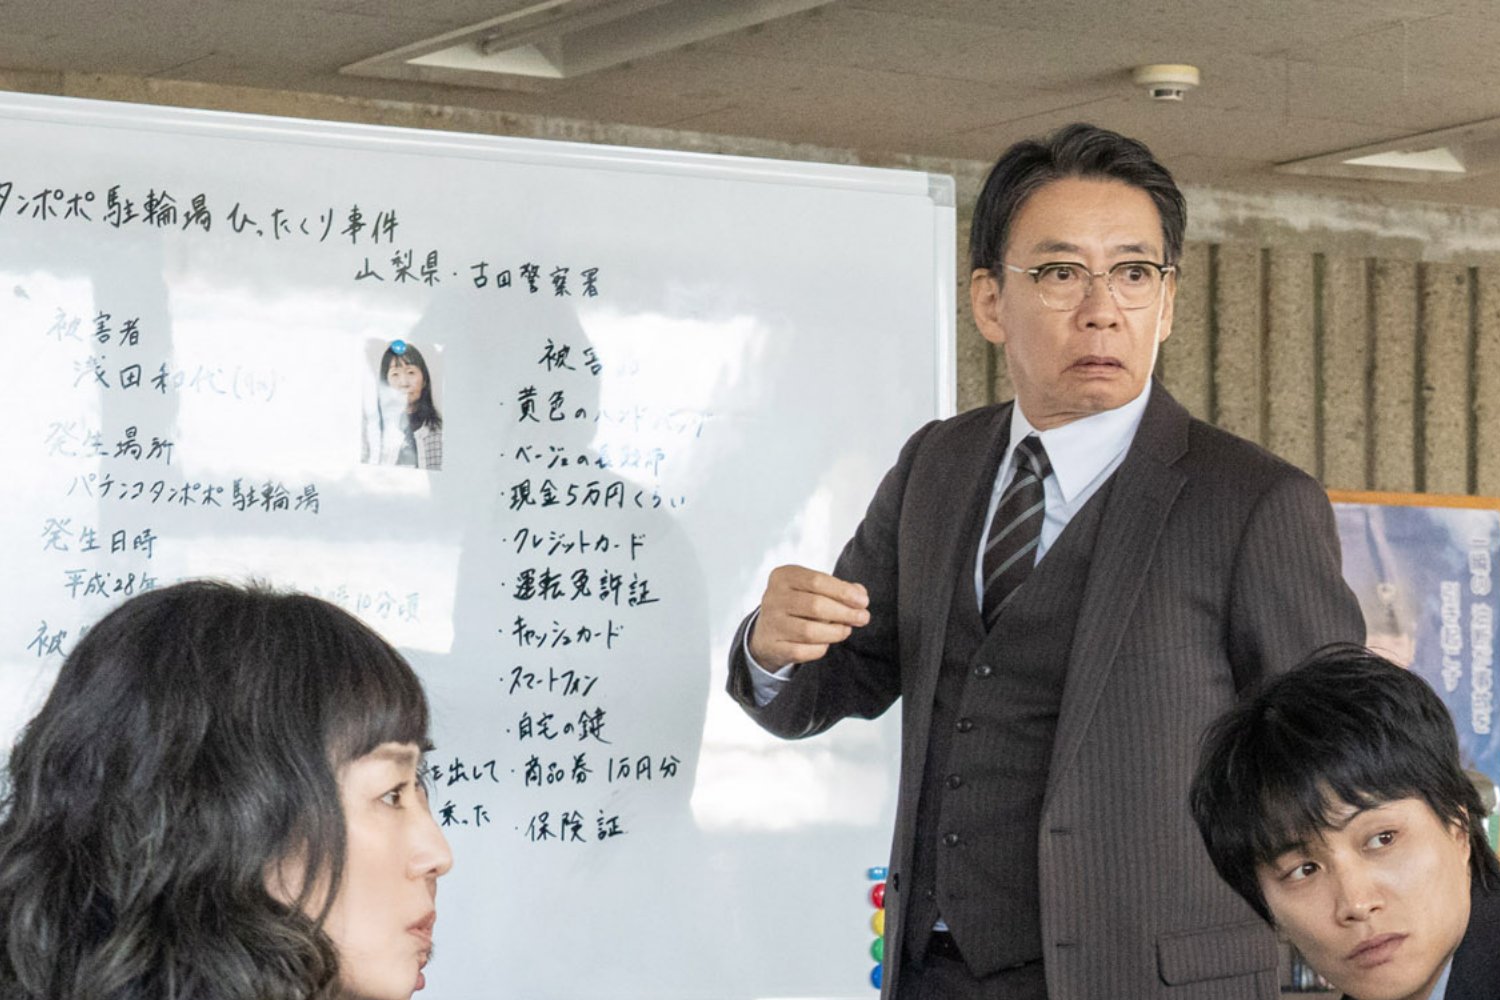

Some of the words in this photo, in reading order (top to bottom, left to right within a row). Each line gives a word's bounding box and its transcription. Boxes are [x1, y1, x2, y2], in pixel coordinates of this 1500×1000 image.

[45, 421, 174, 465] 発生場所
[66, 472, 320, 515] パチンコタンポポ駐輪場
[40, 516, 158, 559] 発生日時
